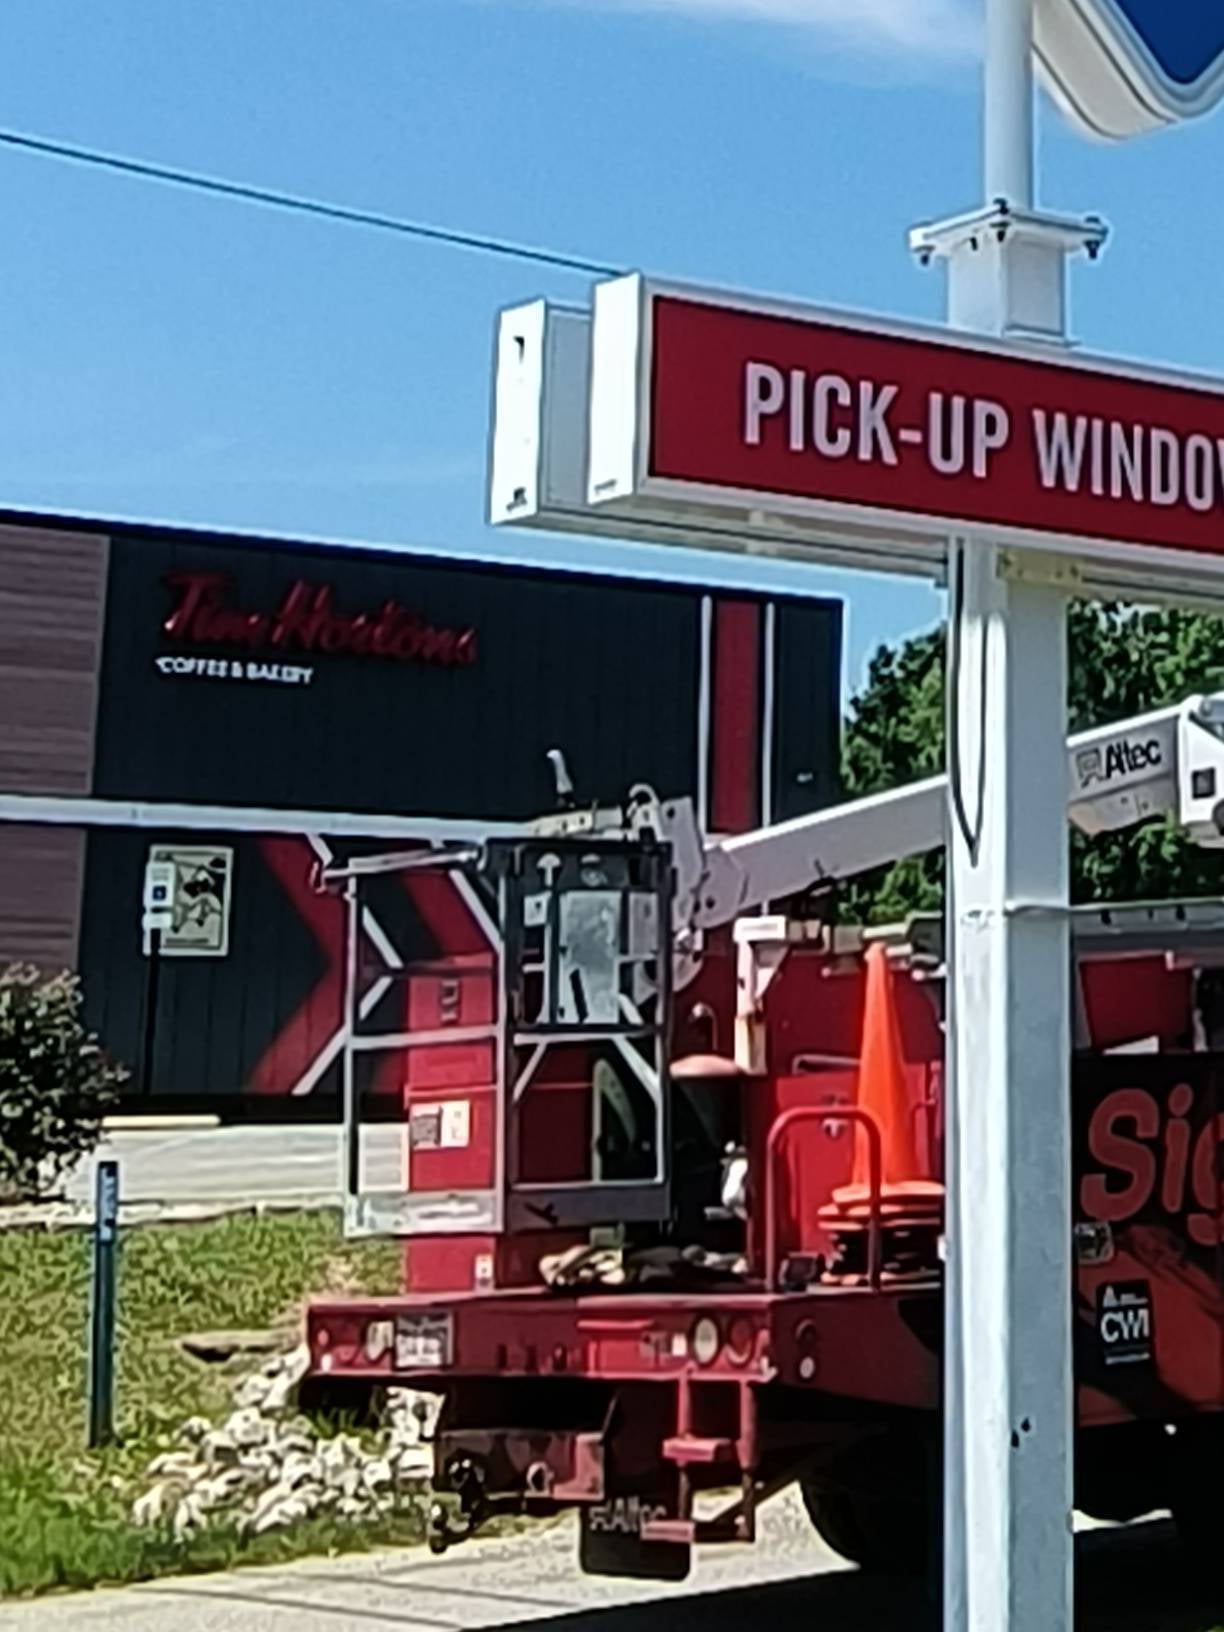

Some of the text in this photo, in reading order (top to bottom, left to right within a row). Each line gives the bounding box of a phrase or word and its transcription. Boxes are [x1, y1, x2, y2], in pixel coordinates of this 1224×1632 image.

[744, 361, 1009, 478] PICK-UP
[162, 570, 478, 667] Tim Hortons
[1105, 739, 1162, 780] Altec
